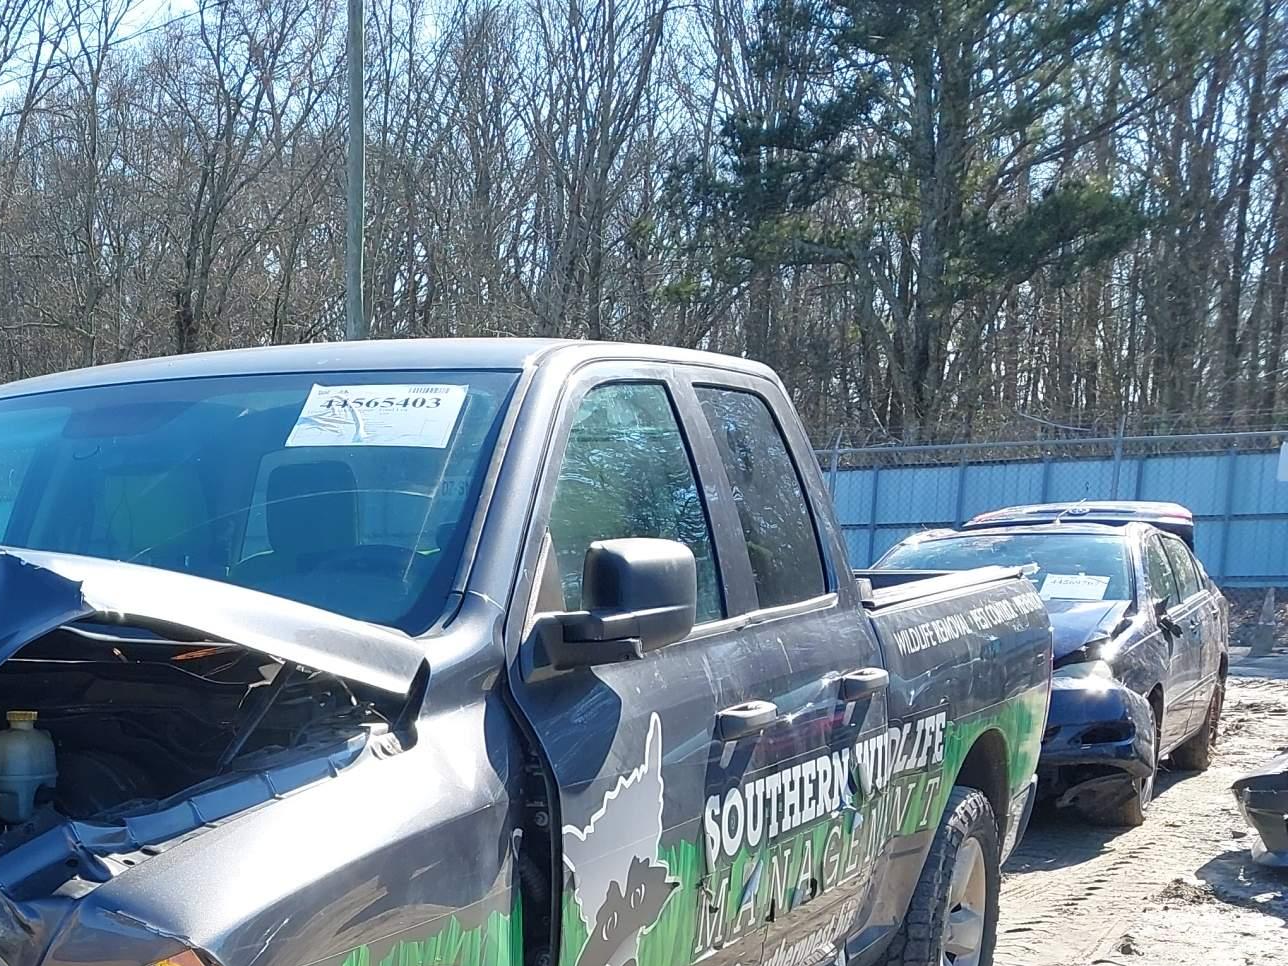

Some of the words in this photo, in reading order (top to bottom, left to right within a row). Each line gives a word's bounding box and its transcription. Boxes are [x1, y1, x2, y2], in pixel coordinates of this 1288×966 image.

[319, 396, 442, 409] 44565403
[893, 621, 938, 657] WILDLIFE
[704, 747, 851, 870] SOUTHERN
